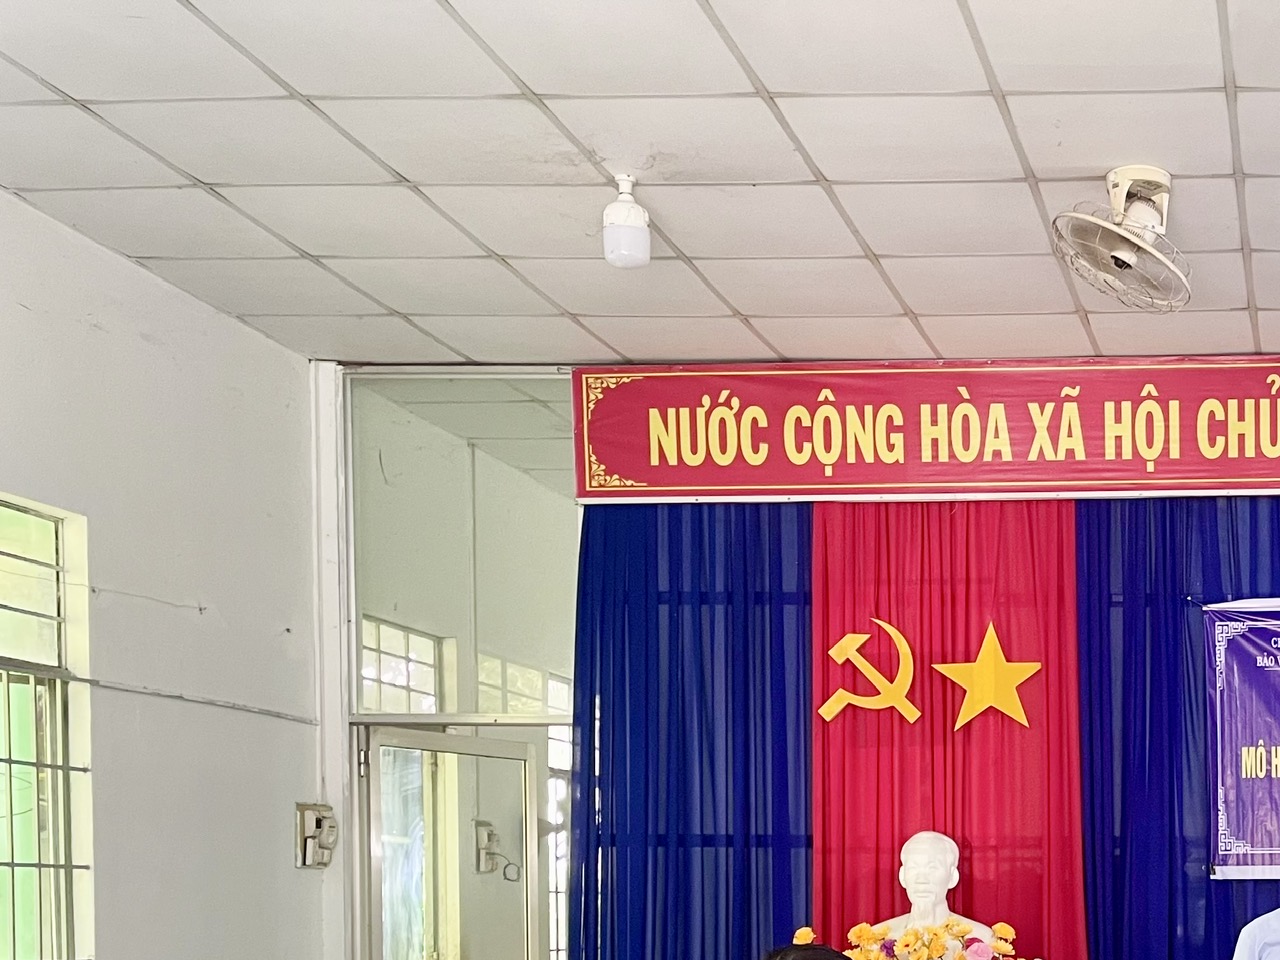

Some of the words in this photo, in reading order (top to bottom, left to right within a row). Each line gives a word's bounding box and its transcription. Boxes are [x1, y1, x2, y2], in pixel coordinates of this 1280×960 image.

[648, 388, 768, 467] NƯỚC
[783, 388, 904, 477] CỘNG
[920, 386, 1012, 463] HÒA
[1028, 386, 1086, 462] XÃ
[1103, 383, 1180, 473] HỘI
[1256, 652, 1275, 667] BẢO
[1241, 740, 1266, 779] MÔ
